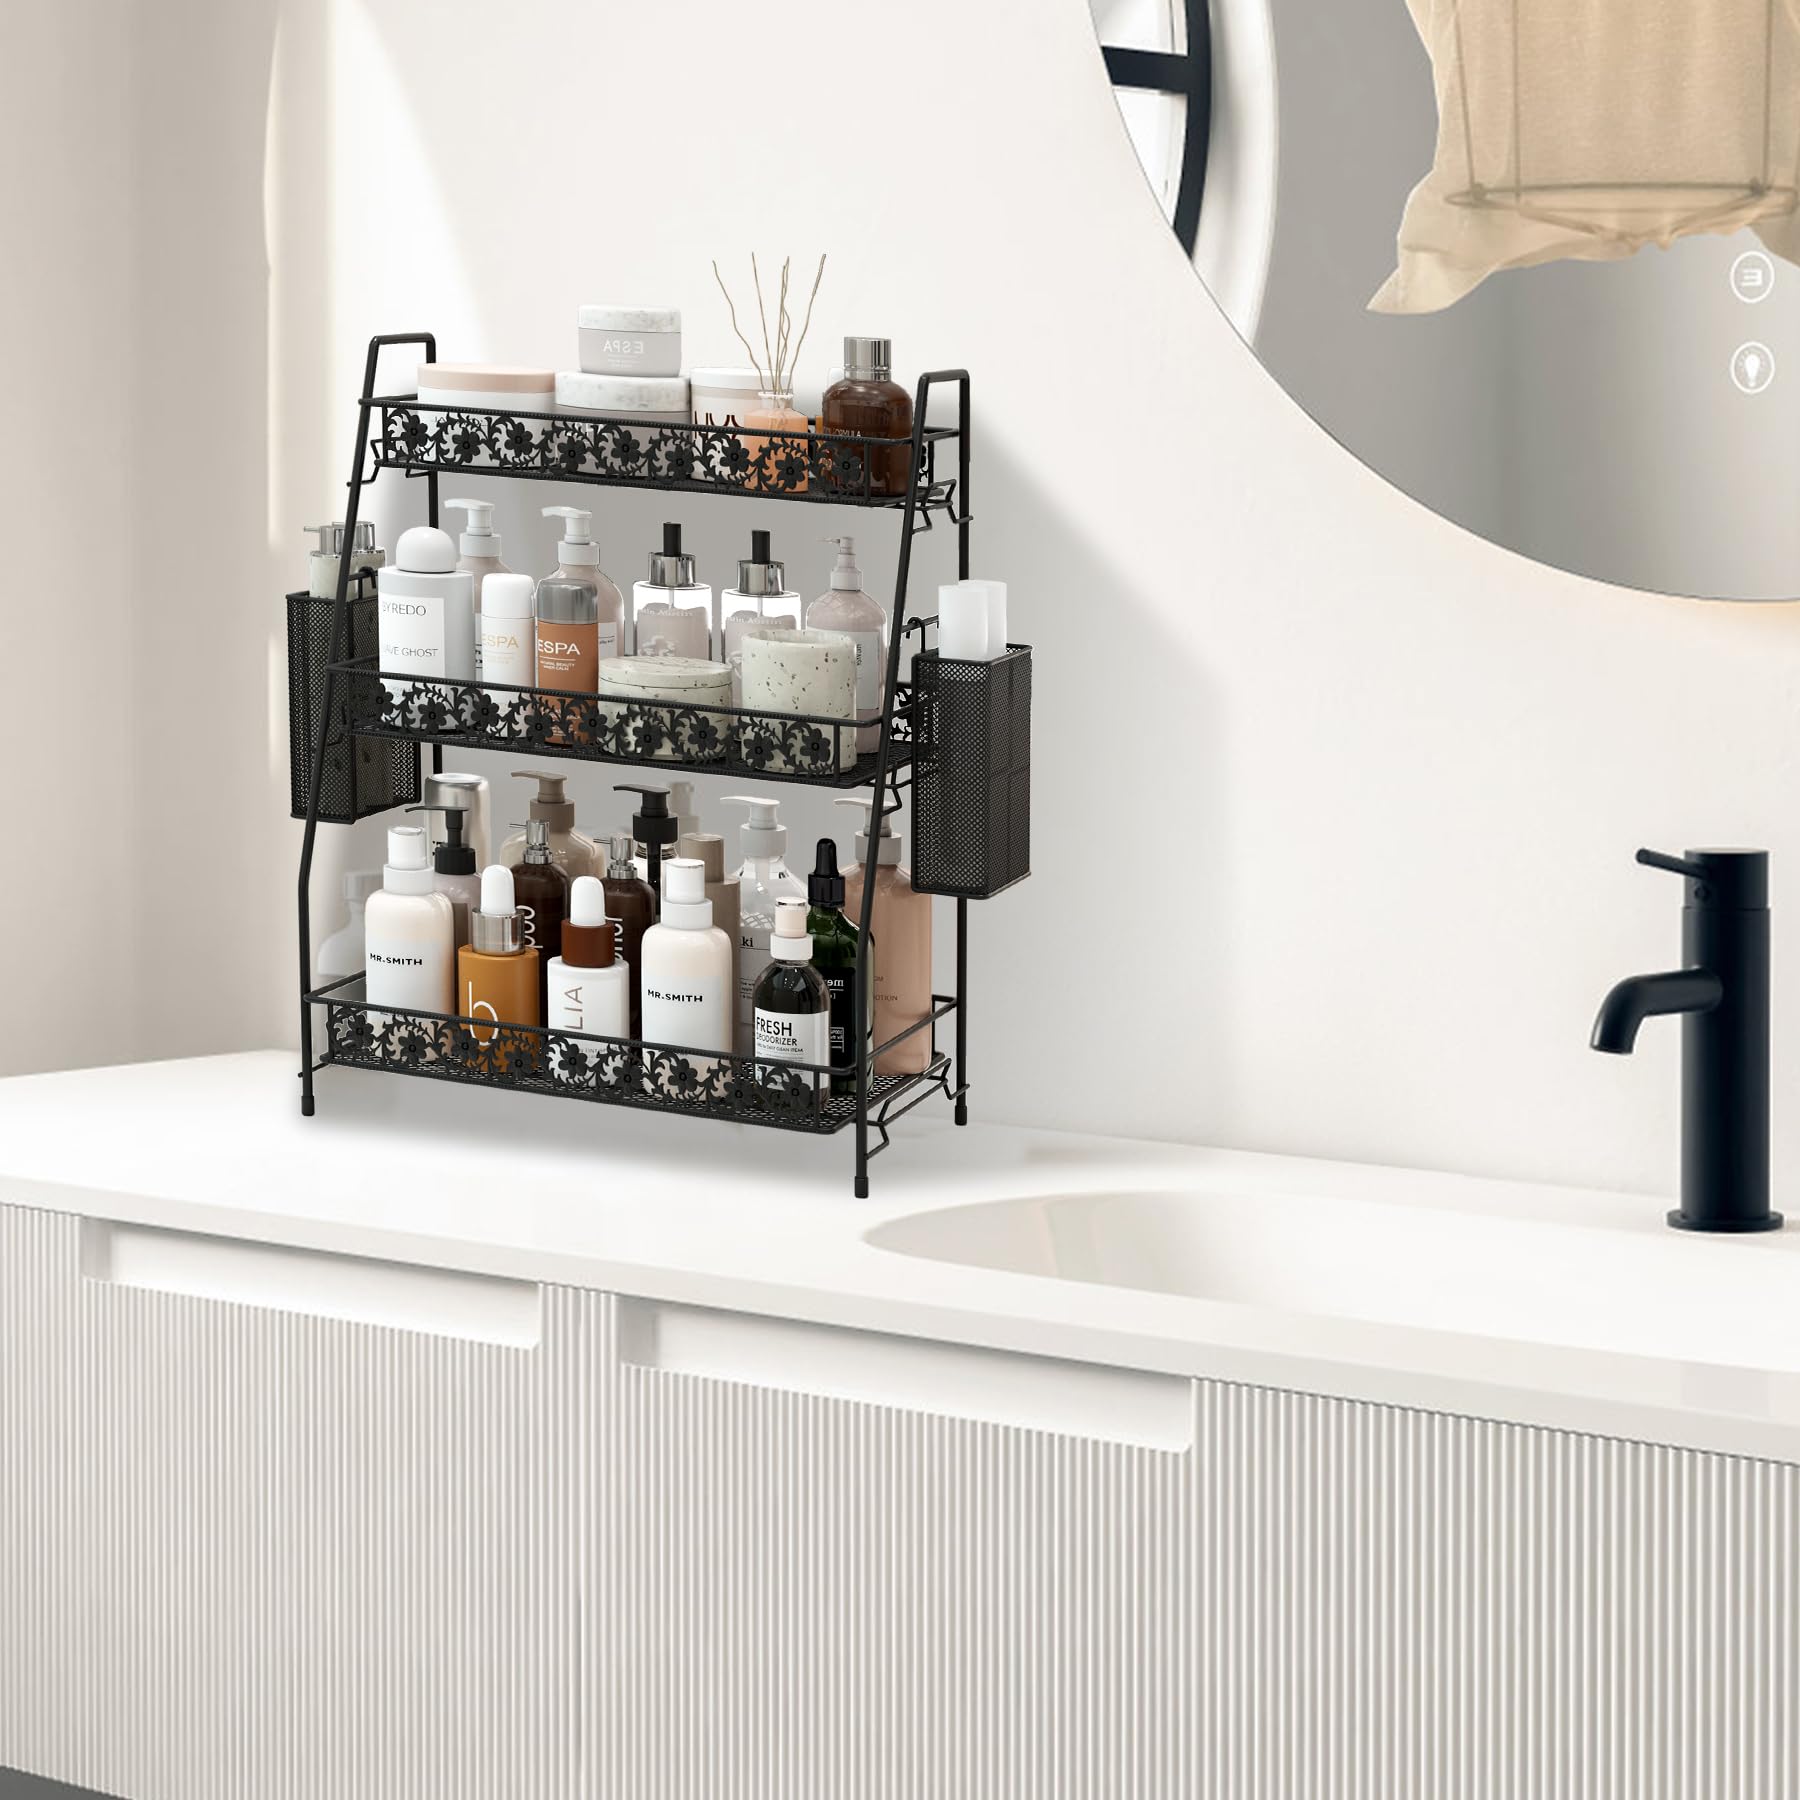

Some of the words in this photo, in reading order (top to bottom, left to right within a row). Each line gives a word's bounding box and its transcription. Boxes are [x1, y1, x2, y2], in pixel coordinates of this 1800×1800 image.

[401, 647, 439, 658] GHOST
[538, 638, 581, 656] ESPA
[369, 952, 423, 966] MR.SMITH
[647, 988, 703, 1003] MR.SMITH
[873, 994, 898, 1002] OTION
[756, 1016, 793, 1037] FRESH
